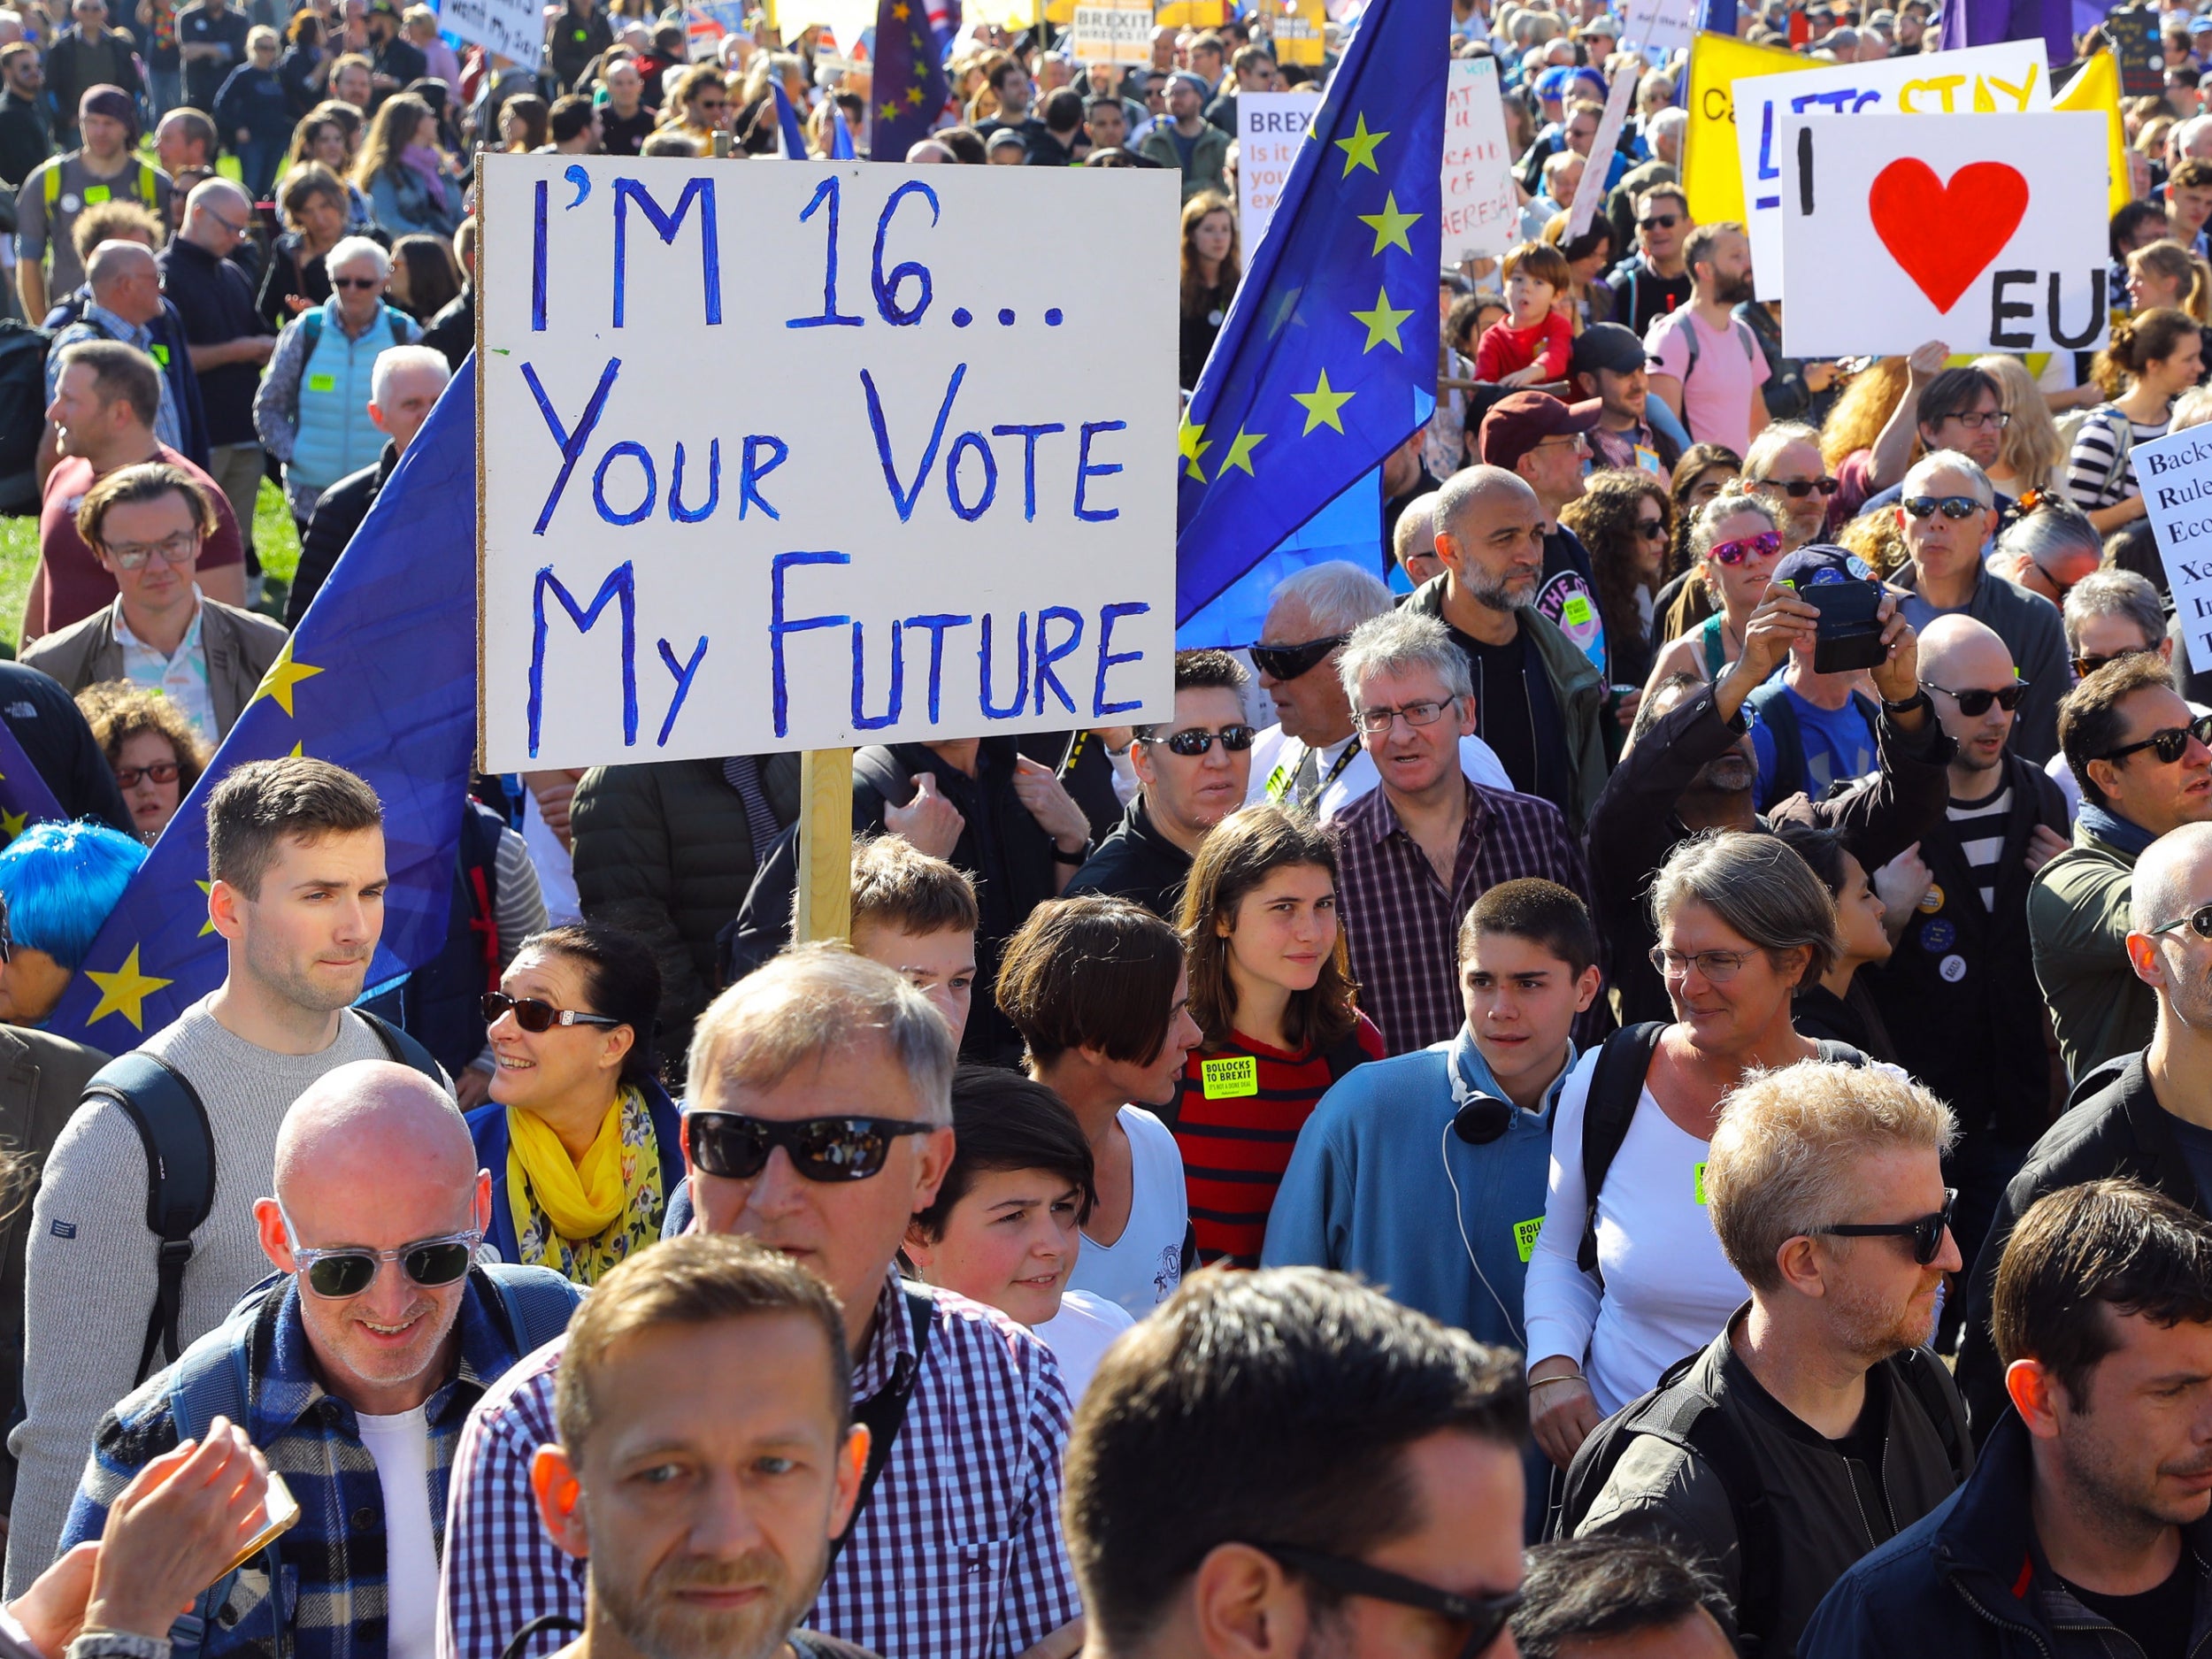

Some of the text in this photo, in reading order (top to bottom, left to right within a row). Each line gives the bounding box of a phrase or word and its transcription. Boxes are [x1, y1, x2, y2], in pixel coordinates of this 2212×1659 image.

[1077, 11, 1149, 27] BREXIT
[1250, 142, 1290, 162] Is it
[1798, 127, 1815, 216] I
[531, 164, 1064, 331] I'M 16...
[1991, 269, 2106, 348] EU
[1540, 579, 1570, 619] THE
[1206, 1060, 1250, 1073] BOLLOCKS
[1206, 1070, 1251, 1083] TO BREXIT
[1520, 1234, 1533, 1245] TO
